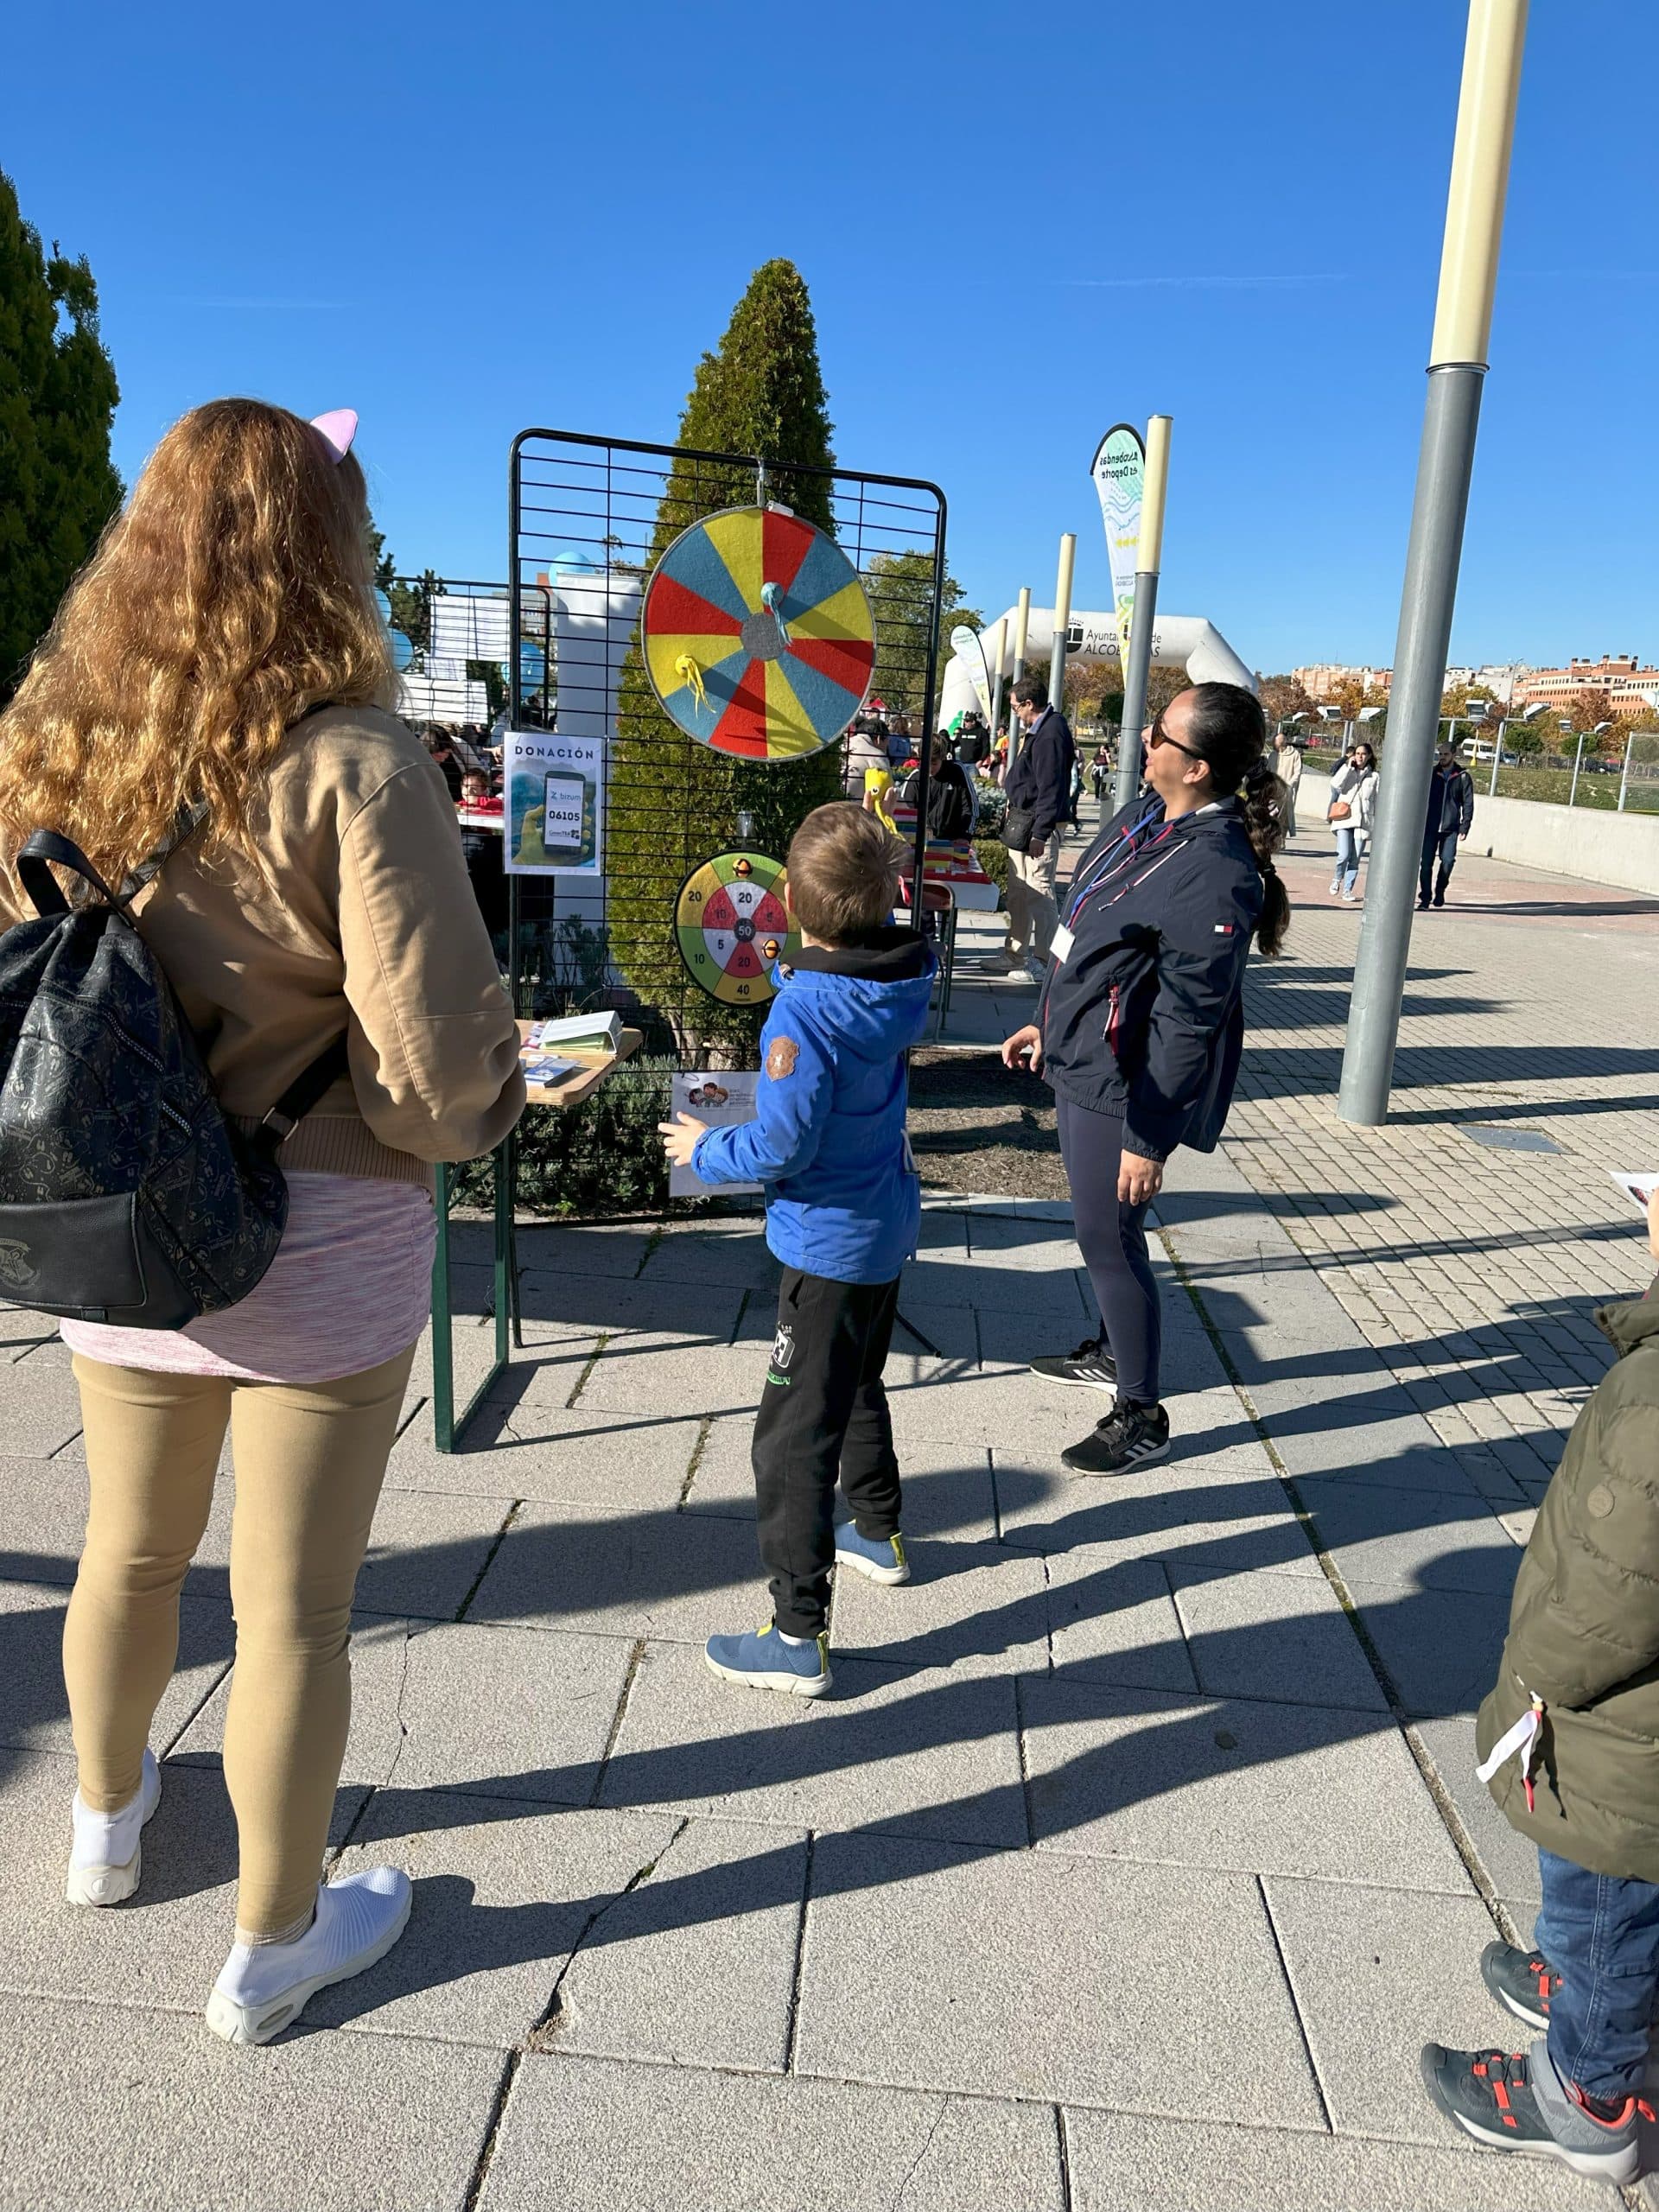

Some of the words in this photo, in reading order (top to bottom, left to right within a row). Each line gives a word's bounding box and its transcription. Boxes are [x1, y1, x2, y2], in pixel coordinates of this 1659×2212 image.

[515, 746, 594, 760] DONACIÓN
[560, 791, 582, 801] bizum
[549, 810, 581, 821] 06105
[688, 891, 702, 902] 20
[739, 893, 752, 904] 20
[716, 909, 727, 919] 10
[766, 912, 772, 922] 5
[738, 925, 752, 937] 50
[718, 939, 724, 950] 5
[694, 953, 705, 963] 10
[738, 957, 750, 968] 20
[737, 984, 750, 995] 40
